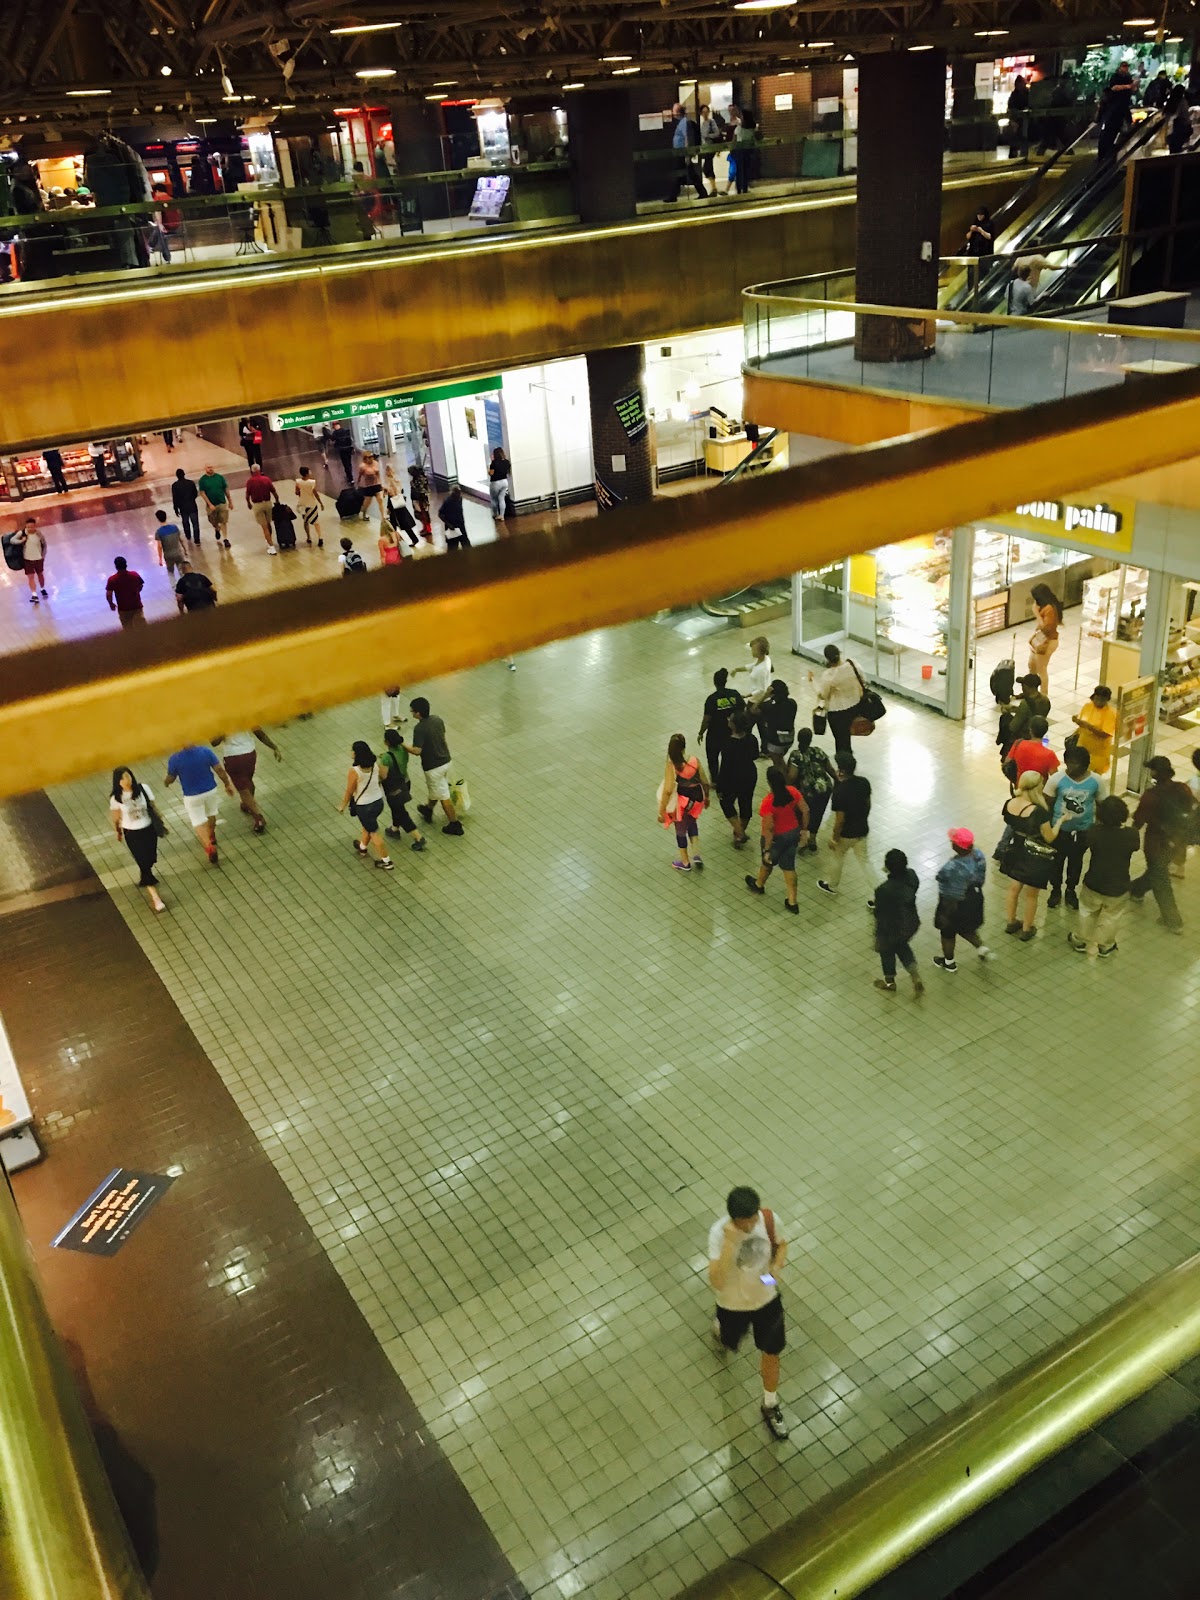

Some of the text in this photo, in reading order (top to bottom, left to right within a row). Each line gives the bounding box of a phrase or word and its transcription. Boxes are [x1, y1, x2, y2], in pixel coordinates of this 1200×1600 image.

[295, 413, 316, 423] Avenue
[331, 408, 345, 416] Taxis
[359, 402, 379, 411] Parking
[393, 396, 414, 405] Subway
[1065, 504, 1117, 534] pain
[81, 1189, 119, 1228] Don't ignore
[81, 1209, 115, 1243] something
[119, 1179, 139, 1196] looks
